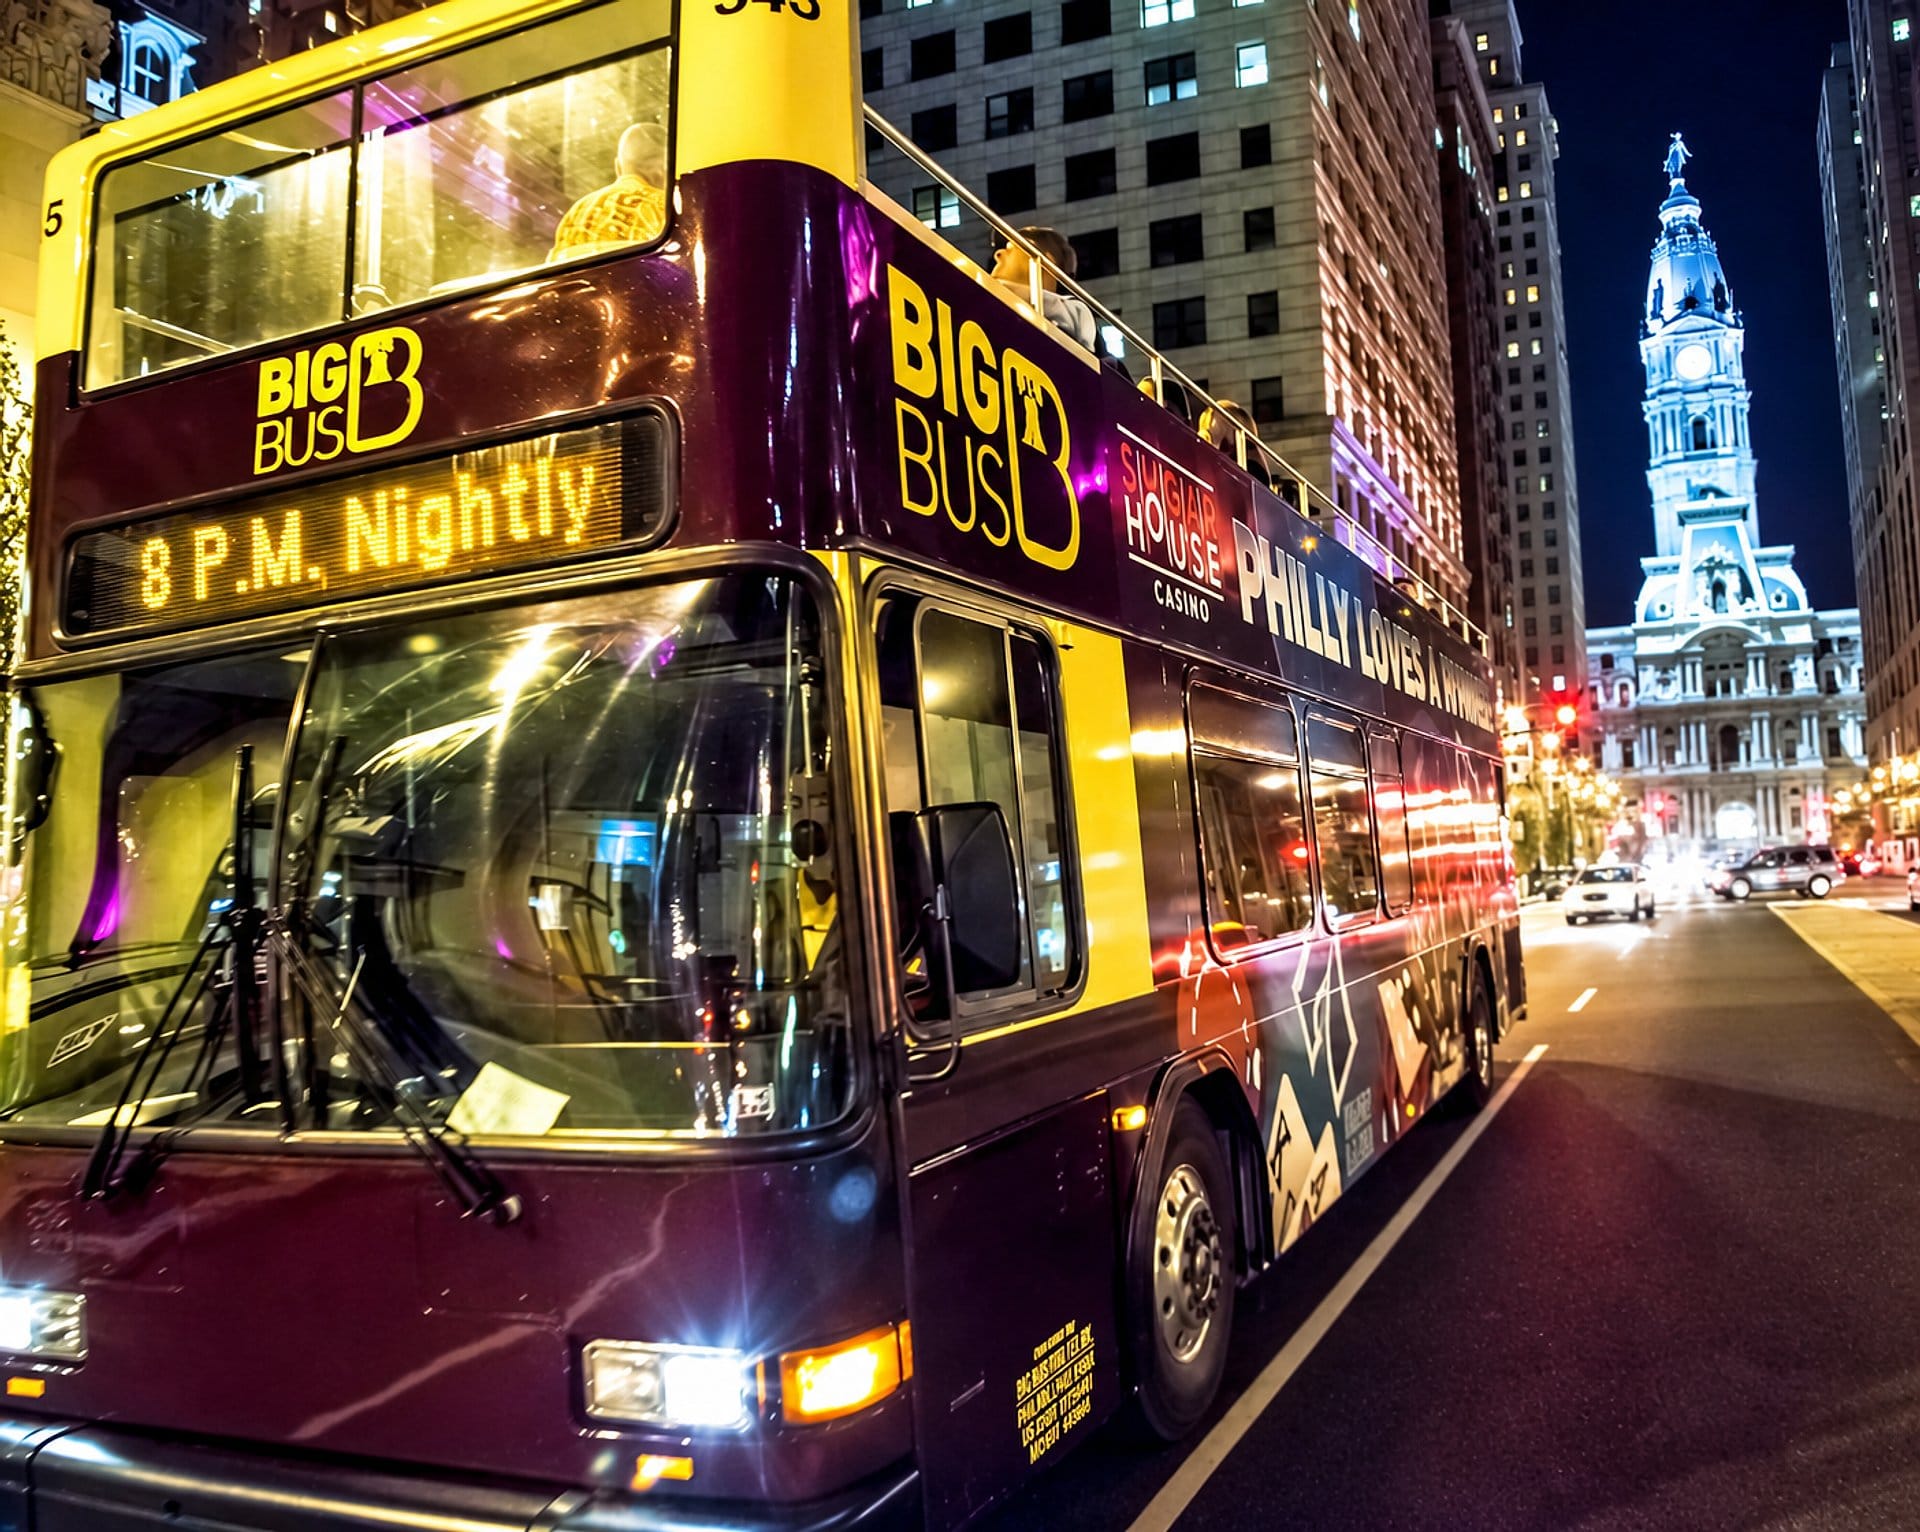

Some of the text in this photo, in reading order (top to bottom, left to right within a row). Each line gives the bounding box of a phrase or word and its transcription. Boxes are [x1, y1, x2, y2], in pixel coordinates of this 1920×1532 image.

[44, 198, 64, 237] 5
[257, 342, 348, 418] BIG
[887, 263, 1000, 435] BIG
[253, 405, 345, 475] BUS
[895, 397, 1011, 547] BUS
[141, 536, 172, 609] 8
[345, 457, 596, 572] Nightly
[1120, 441, 1218, 539] SUGAR
[1124, 491, 1222, 589] HOUSE
[1153, 579, 1210, 623] CASINO
[1231, 516, 1351, 669] PHILLY
[1354, 596, 1427, 702] LOVES
[1427, 645, 1443, 709] A
